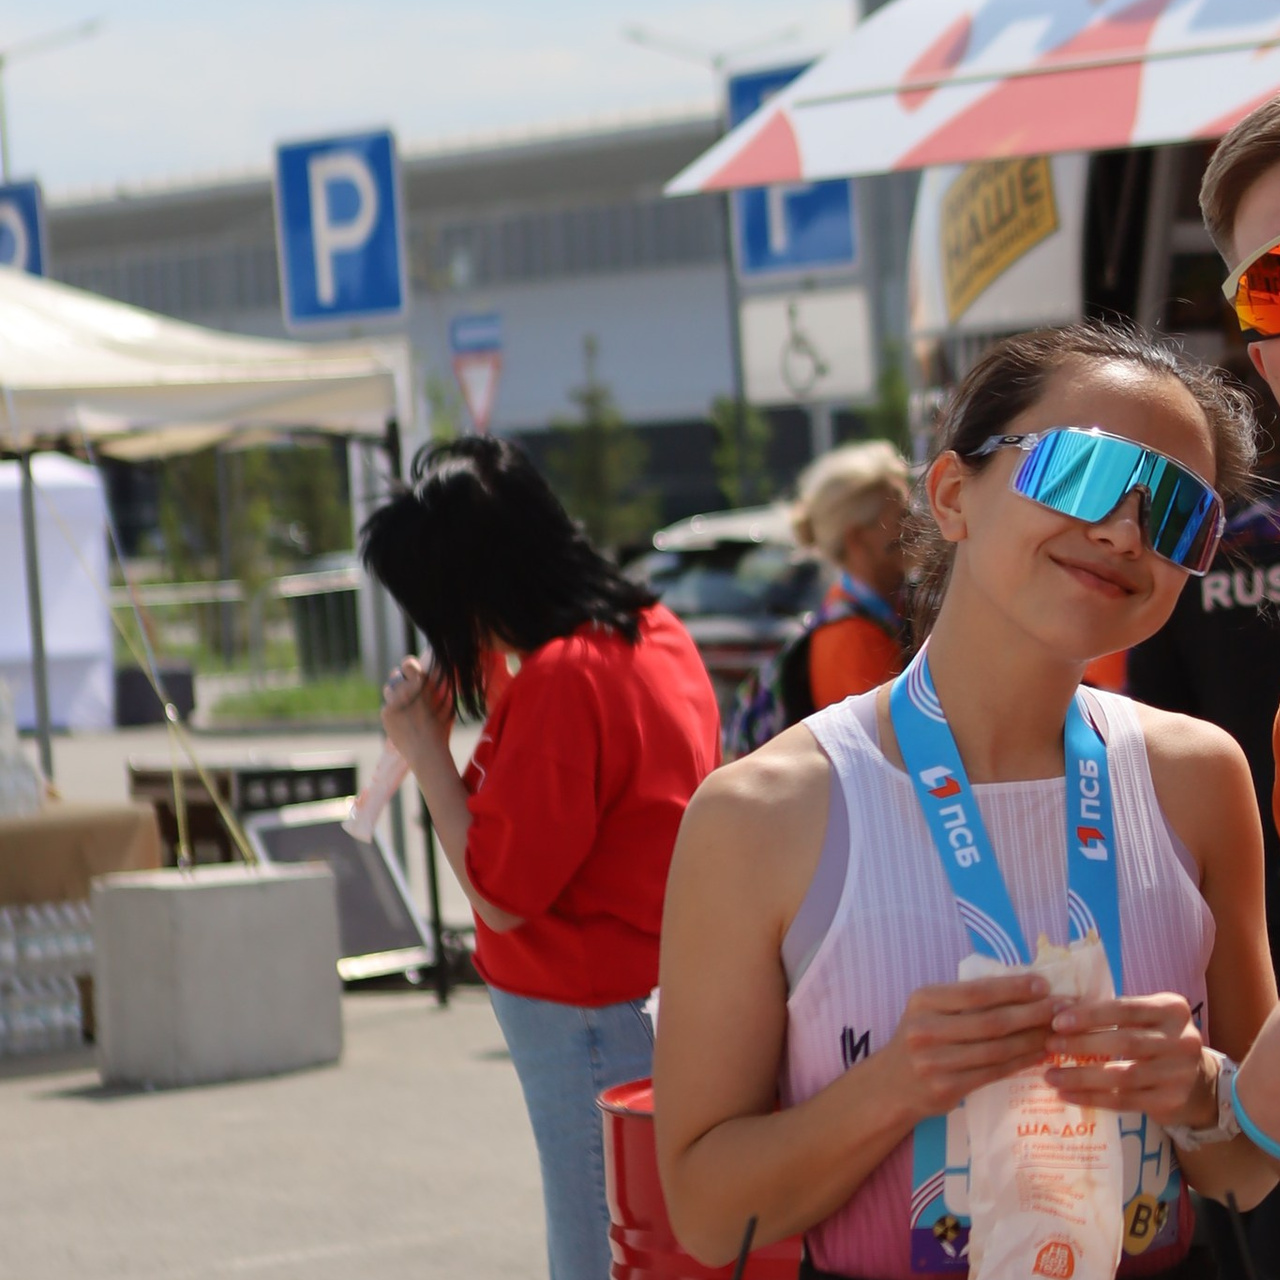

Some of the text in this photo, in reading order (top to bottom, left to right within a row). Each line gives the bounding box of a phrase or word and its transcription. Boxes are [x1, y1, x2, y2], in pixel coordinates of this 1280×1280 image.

[306, 152, 379, 308] P
[1078, 759, 1101, 820] ПСБ
[939, 803, 982, 869] ПСБ
